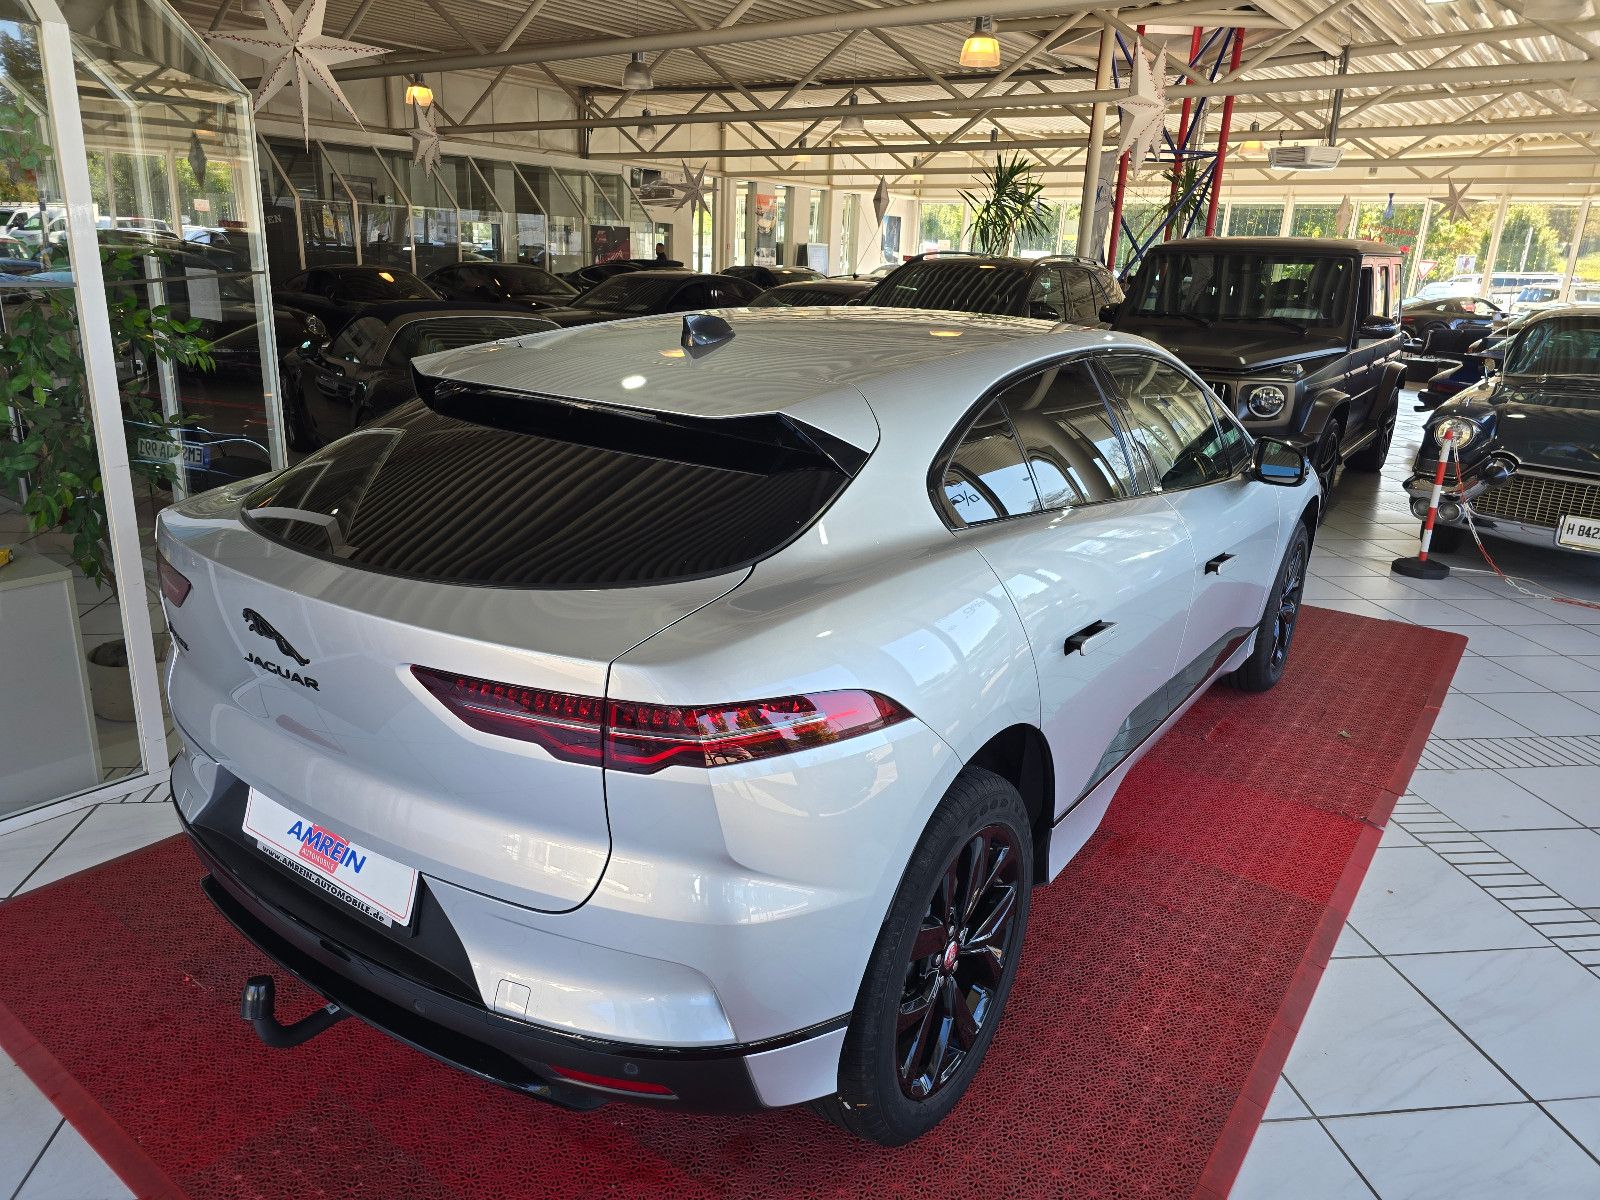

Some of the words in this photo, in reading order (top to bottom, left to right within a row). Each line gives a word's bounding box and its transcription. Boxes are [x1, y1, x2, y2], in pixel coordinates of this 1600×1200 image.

[1566, 523, 1575, 535] H
[1577, 525, 1600, 540] 842
[243, 652, 321, 692] JAGUAR
[286, 820, 367, 874] AMREIN
[261, 844, 386, 923] www.AMREIN-AUTOMOBILE.de
